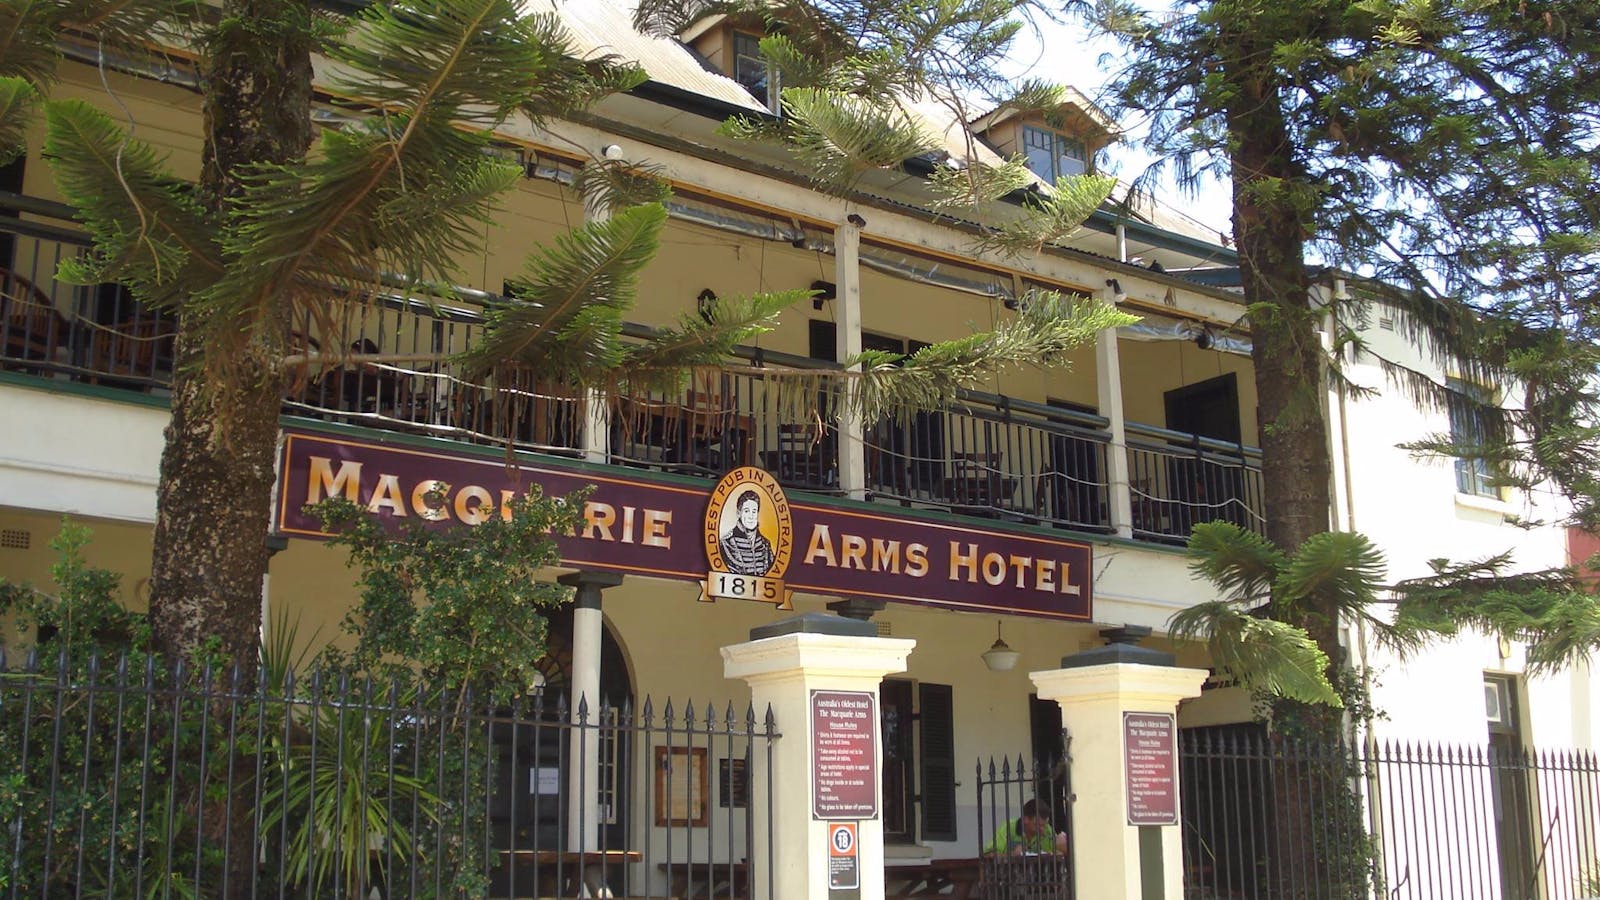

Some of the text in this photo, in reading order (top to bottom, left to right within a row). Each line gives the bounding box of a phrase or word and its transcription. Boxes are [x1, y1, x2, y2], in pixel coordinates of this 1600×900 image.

[707, 469, 790, 574] OLDEST PUB IN AUSTRALIA
[803, 523, 929, 577] ARMS
[949, 541, 1081, 597] HOTEL
[720, 576, 776, 599] 1815
[820, 710, 828, 718] The
[830, 710, 854, 719] Macquarie
[838, 835, 848, 848] 18
